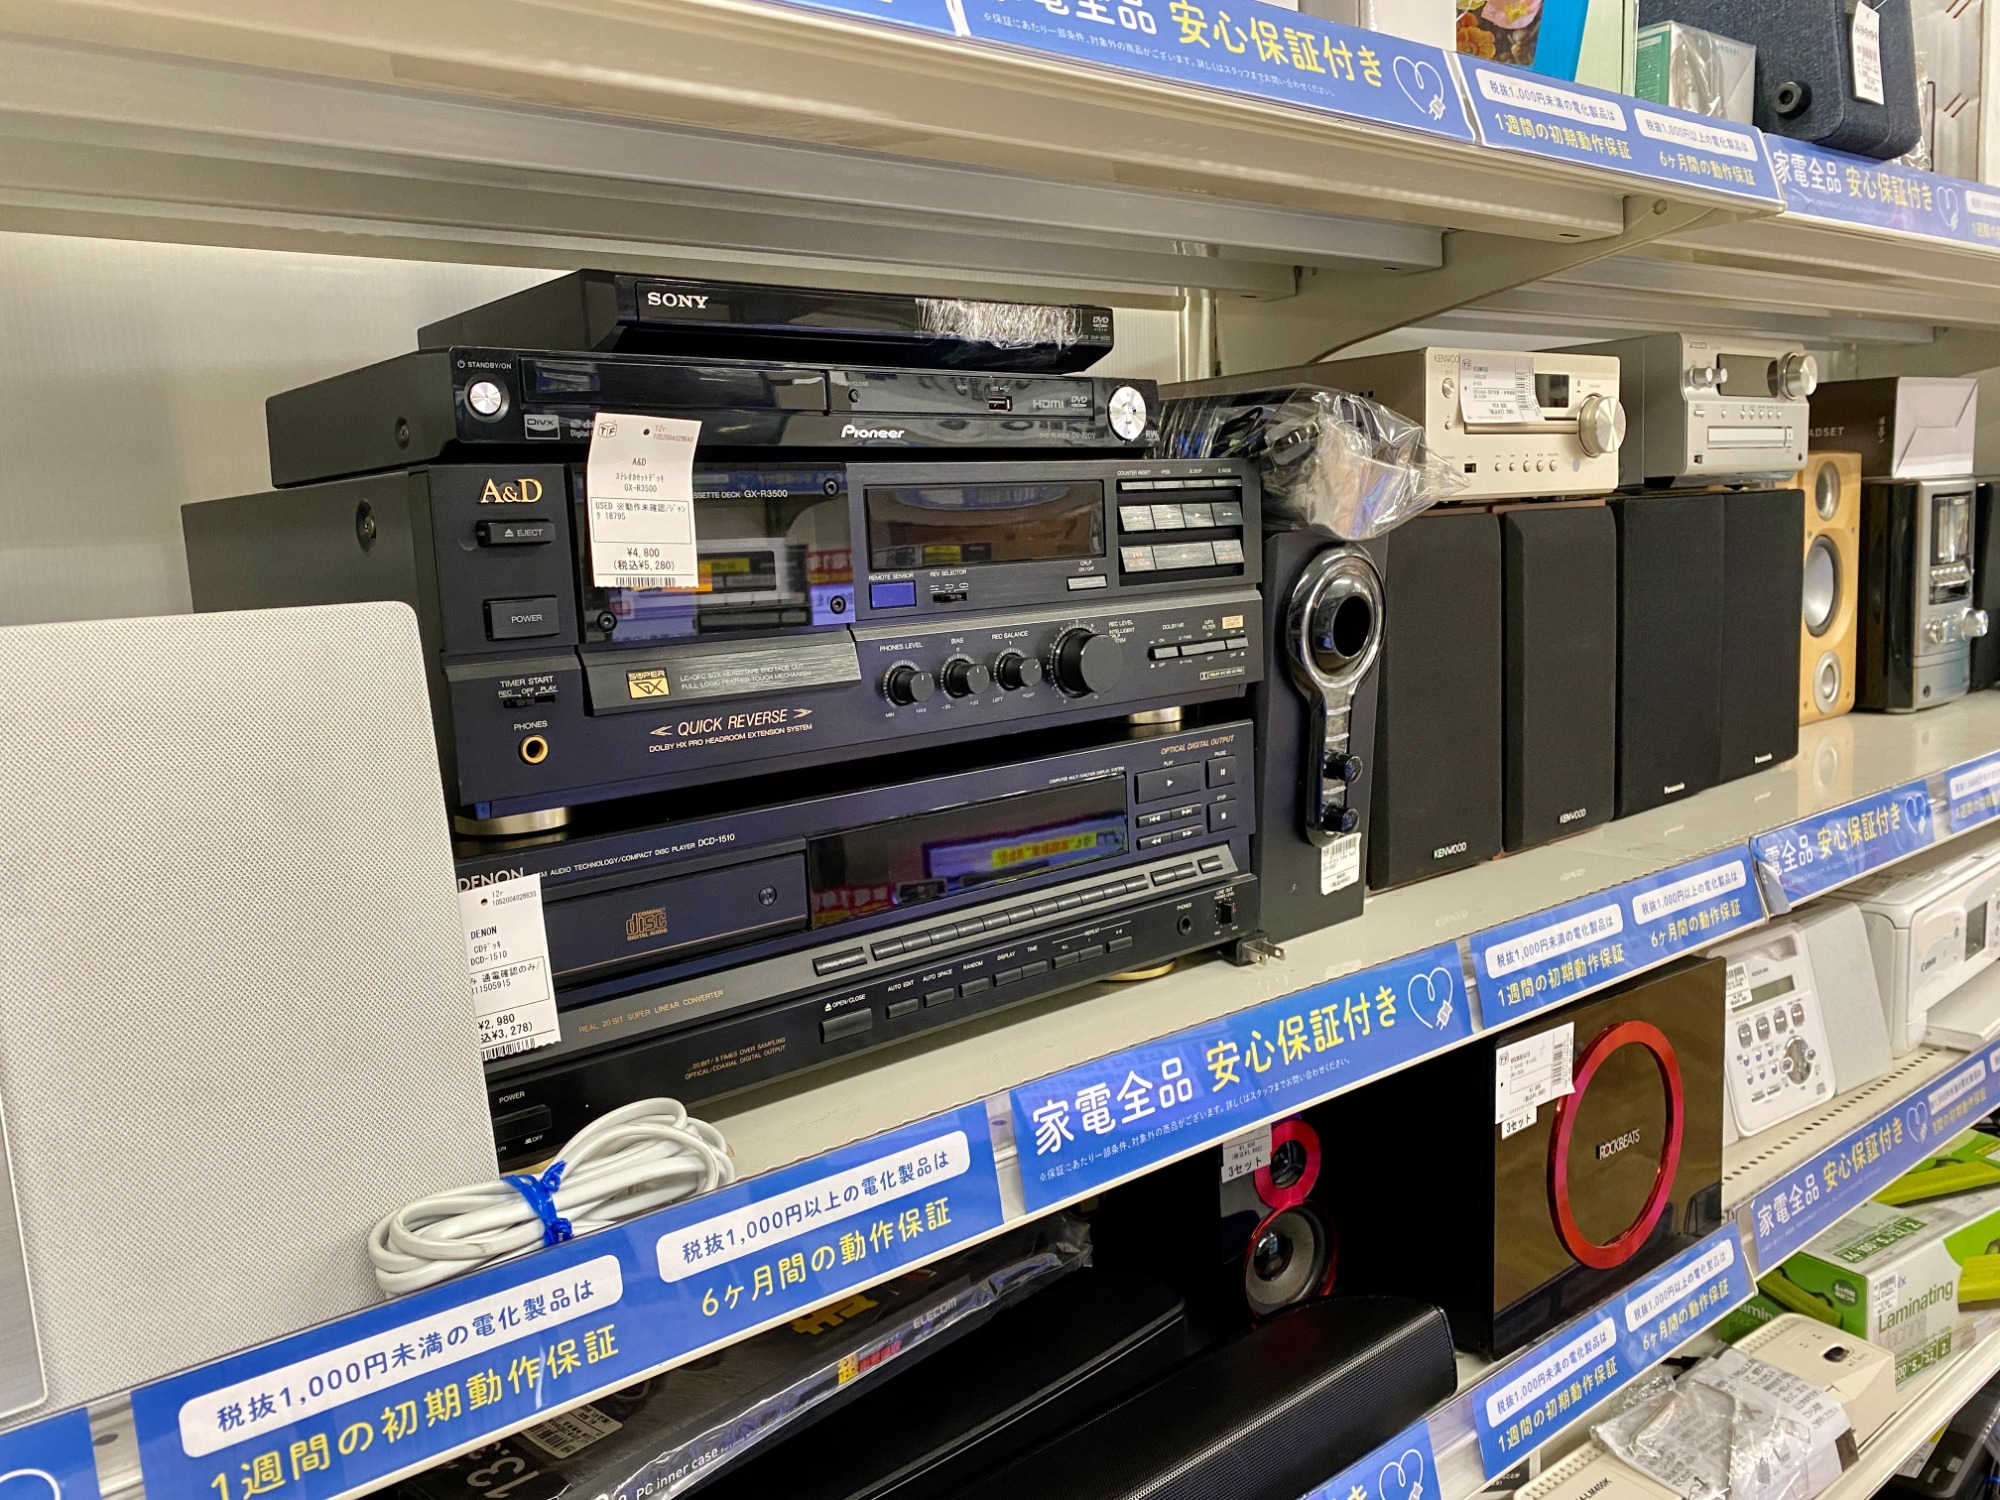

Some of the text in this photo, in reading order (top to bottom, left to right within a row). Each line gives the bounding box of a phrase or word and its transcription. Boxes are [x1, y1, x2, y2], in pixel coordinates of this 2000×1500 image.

[1000, 0, 1382, 87] 全品 安心保証付き
[1489, 78, 1617, 122] 税抜1,000円未満の電化製品は
[1494, 111, 1633, 161] 1週間の初期動作保証
[1773, 149, 1842, 193] 家電全品
[1846, 166, 1933, 212] 安心保証付き
[648, 292, 709, 309] SONY
[1092, 316, 1109, 324] DVD
[467, 361, 512, 370] STANDBY/ON
[1433, 353, 1460, 363] KENWOO
[1071, 396, 1088, 404] DVD
[570, 429, 589, 438] Digital
[841, 424, 905, 439] Pioneer
[1809, 426, 1845, 438] ADSET
[631, 457, 647, 466] A&D
[479, 478, 543, 503] A&D
[624, 484, 658, 492] GX-R3500
[744, 489, 788, 498] GX-R3500
[595, 502, 613, 510] USED
[605, 512, 626, 520] 18795
[517, 528, 543, 538] EJECT
[627, 548, 660, 559] ¥4,800
[613, 560, 675, 571] (税込¥5,280)
[892, 572, 914, 580] SENSOR
[511, 613, 543, 624] POWER
[1004, 631, 1028, 639] BALANCE
[880, 644, 904, 652] PHONES
[500, 675, 554, 688] TIMER START
[628, 671, 665, 681] SUPER
[681, 671, 812, 690] FULL LOGIC FEATHER TOUCH MECHANISM
[498, 689, 512, 697] REC
[521, 687, 535, 695] OFF
[540, 684, 558, 693] PLAY
[513, 720, 548, 731] PHONES
[678, 709, 788, 736] QUICK REVERSE
[649, 723, 813, 753] DOLBY HX PRO HEADROOM EXTENSION SYSTEM
[1161, 734, 1235, 755] OPTICAL DIGITAL OUTPUT
[1559, 808, 1587, 825] KENWOOD
[1765, 834, 1814, 879] 電全品
[1817, 801, 1901, 860] 安心保証付き
[1433, 841, 1467, 860] KENWOOD
[458, 833, 735, 893] DENON AUDIO TECHNOLOGY/COMPACT DISC PLAYER DCD-1510
[1640, 869, 1740, 917] 税抜1,000円以上の電化製品は
[637, 907, 666, 917] COMPACT
[626, 911, 667, 936] disc
[470, 926, 497, 940] DENON
[627, 928, 668, 941] DIGITAL AUDIO
[1027, 945, 1038, 953] TIME
[1496, 914, 1615, 969] 税抜1,000円未満の電化製品は
[470, 951, 508, 966] DCD-1510
[996, 951, 1016, 961] DISPLAY
[963, 960, 984, 970] RANDOM
[922, 968, 953, 982] AUTO SPACE
[1498, 945, 1625, 1009] 1週間の初期動作保証
[888, 979, 915, 992] AUTO EDIT
[832, 993, 866, 1008] OPEN/CLOSE
[578, 990, 724, 1034] REAL SUPER LINEAR CONVERTER
[481, 1021, 533, 1044] 込¥3,278)
[740, 1047, 756, 1056] OVER
[757, 1037, 786, 1051] SAMPLING
[685, 1045, 786, 1080] OPTICAL/COAXIAL DIGITAL OUTPUT
[1033, 986, 1397, 1156] 家電全品 安心保証付き
[499, 1091, 525, 1104] POWER
[1507, 1114, 1531, 1133] 3セット
[532, 1134, 544, 1143] OFF
[1600, 1129, 1640, 1160] ROCKBEATS
[1228, 1156, 1262, 1177] 3セット
[1757, 1173, 1820, 1238] 家電全品
[1823, 1117, 1904, 1193] 安心保証付き
[682, 1150, 949, 1264] 税抜1,000円以上の電化製品は
[1634, 1252, 1726, 1320] 税抜1,000円以上の電化製品は
[913, 1296, 957, 1330] ELECOM
[1878, 1280, 1954, 1334] Laminating
[216, 1279, 594, 1433] 税抜1,000円未満の電化製品は
[1497, 1330, 1608, 1416] 税抜1,000円未満の電化製品は
[210, 1322, 619, 1500] 1週間の初期動作保証
[1498, 1357, 1618, 1454] 1週間の初期動作保証
[636, 1447, 718, 1500] PC inner case
